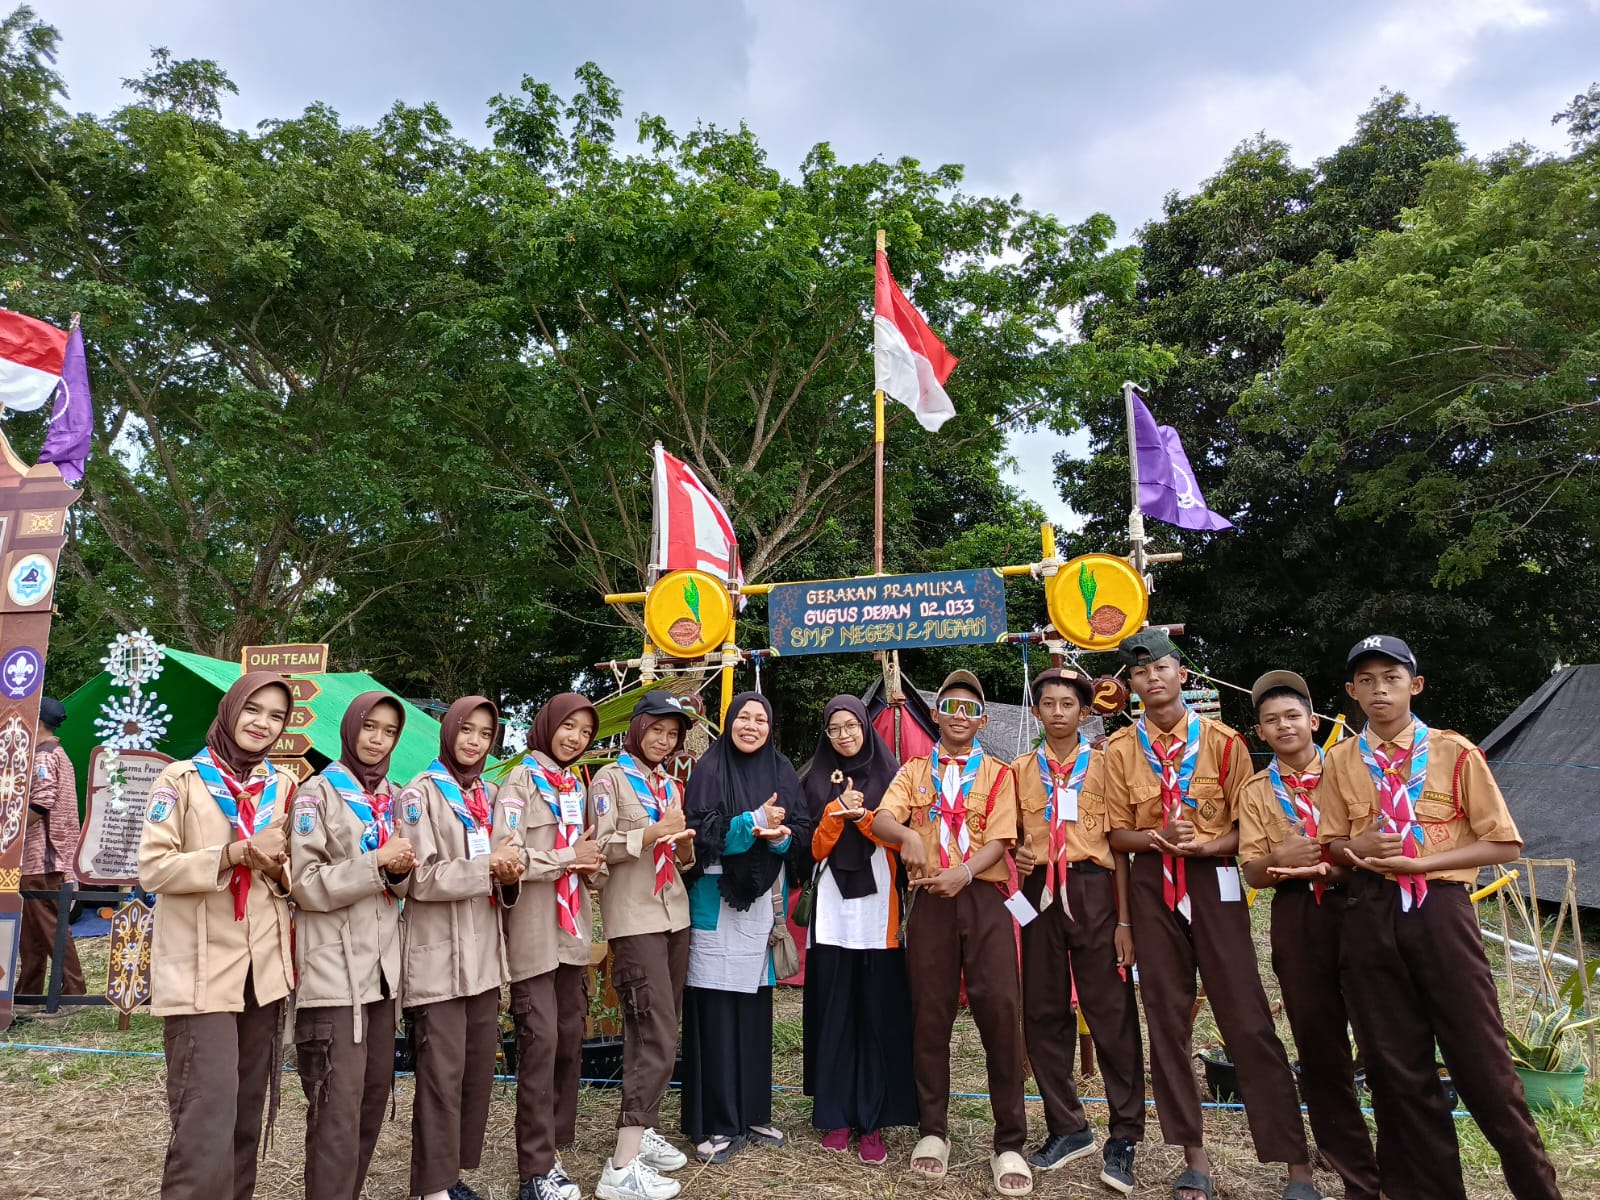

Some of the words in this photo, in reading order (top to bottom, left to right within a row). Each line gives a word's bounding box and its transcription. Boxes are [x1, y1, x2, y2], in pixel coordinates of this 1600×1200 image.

[806, 585, 877, 605] GERAKAN
[882, 580, 966, 599] PRAMUKA
[804, 606, 859, 626] GUGUS
[861, 602, 911, 623] DEPAN
[920, 599, 975, 618] 02.033
[790, 626, 835, 648] SMP
[839, 622, 903, 647] NEGERI
[905, 621, 923, 641] 2
[921, 615, 987, 641] PUGAAN
[250, 653, 280, 666] OUR
[282, 652, 320, 665] TEAM
[1093, 681, 1118, 710] 2
[674, 757, 692, 781] M
